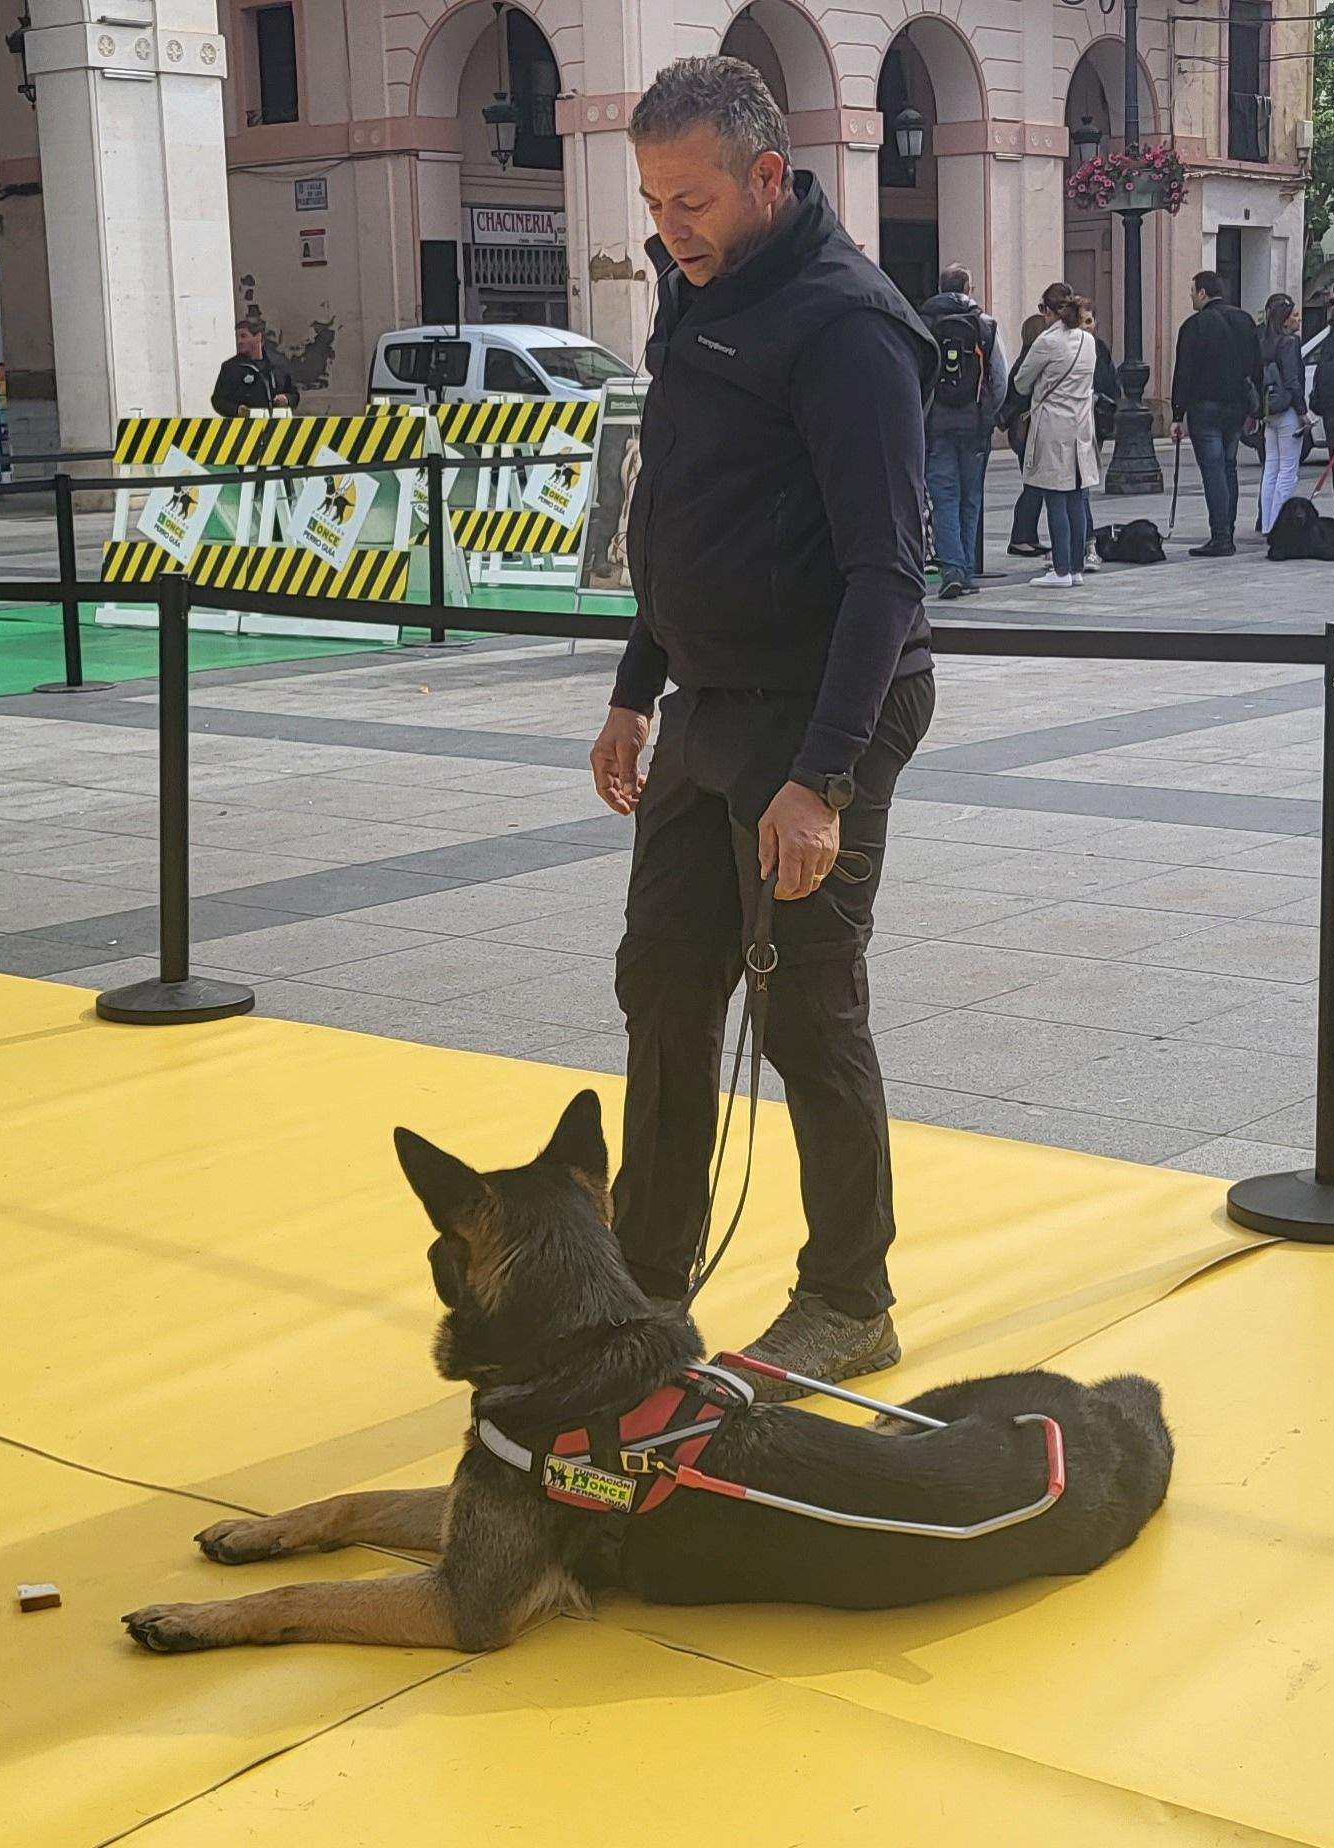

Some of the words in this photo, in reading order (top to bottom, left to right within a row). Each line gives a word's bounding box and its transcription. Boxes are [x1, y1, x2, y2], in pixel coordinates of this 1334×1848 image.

[476, 211, 554, 234] CHACINERIA
[548, 489, 570, 508] ONCE
[165, 518, 186, 540] ONCE
[303, 530, 321, 547] PERRO
[316, 524, 342, 547] ONCE
[573, 1467, 630, 1490] FUNDACIÓN
[589, 1482, 627, 1500] ONCE
